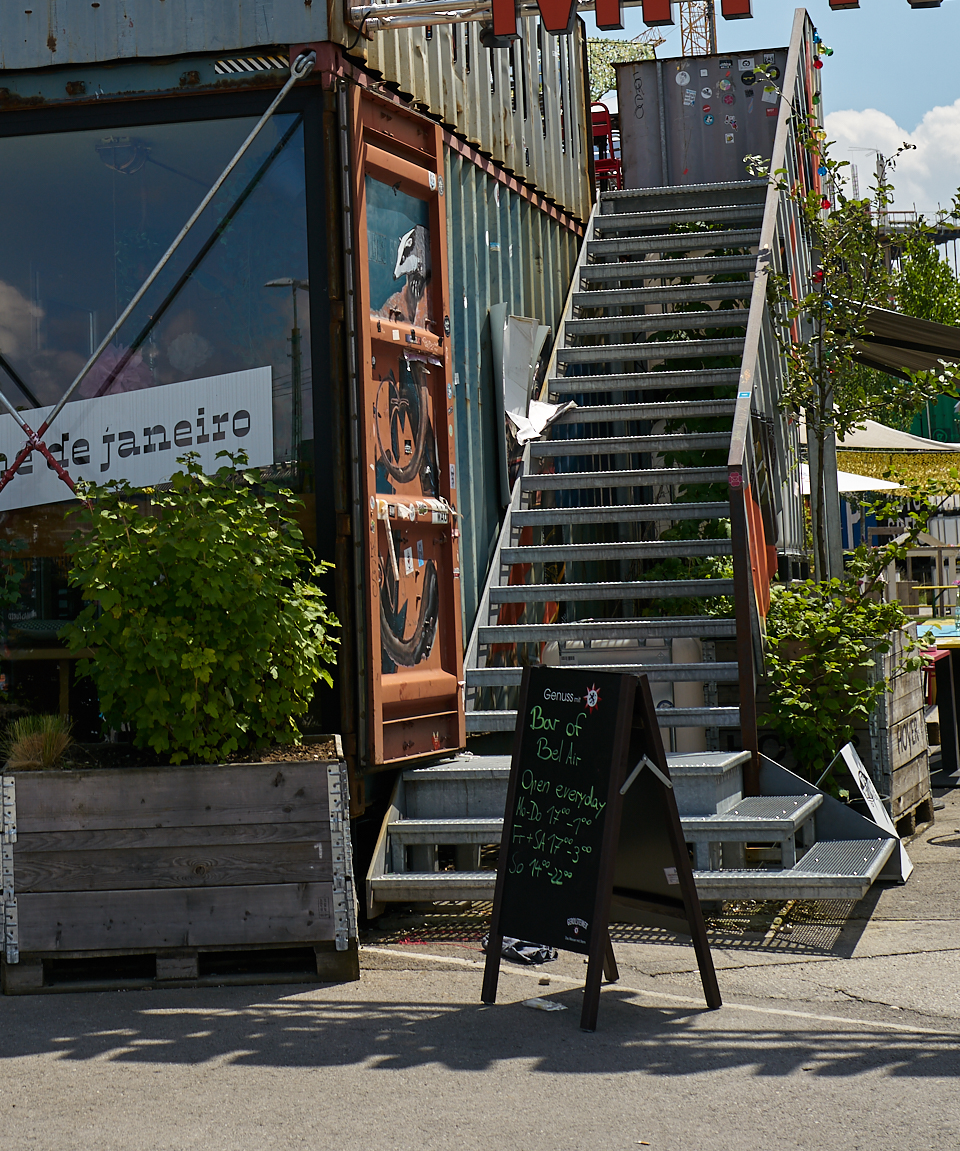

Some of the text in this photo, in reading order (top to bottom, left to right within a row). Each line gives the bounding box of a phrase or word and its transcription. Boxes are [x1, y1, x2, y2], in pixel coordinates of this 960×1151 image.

[47, 432, 90, 470] de
[100, 407, 251, 472] janeiro
[543, 688, 574, 702] Genuss
[530, 705, 587, 736] Bar of
[537, 737, 582, 766] Bel Air
[522, 769, 606, 819] Open everyday
